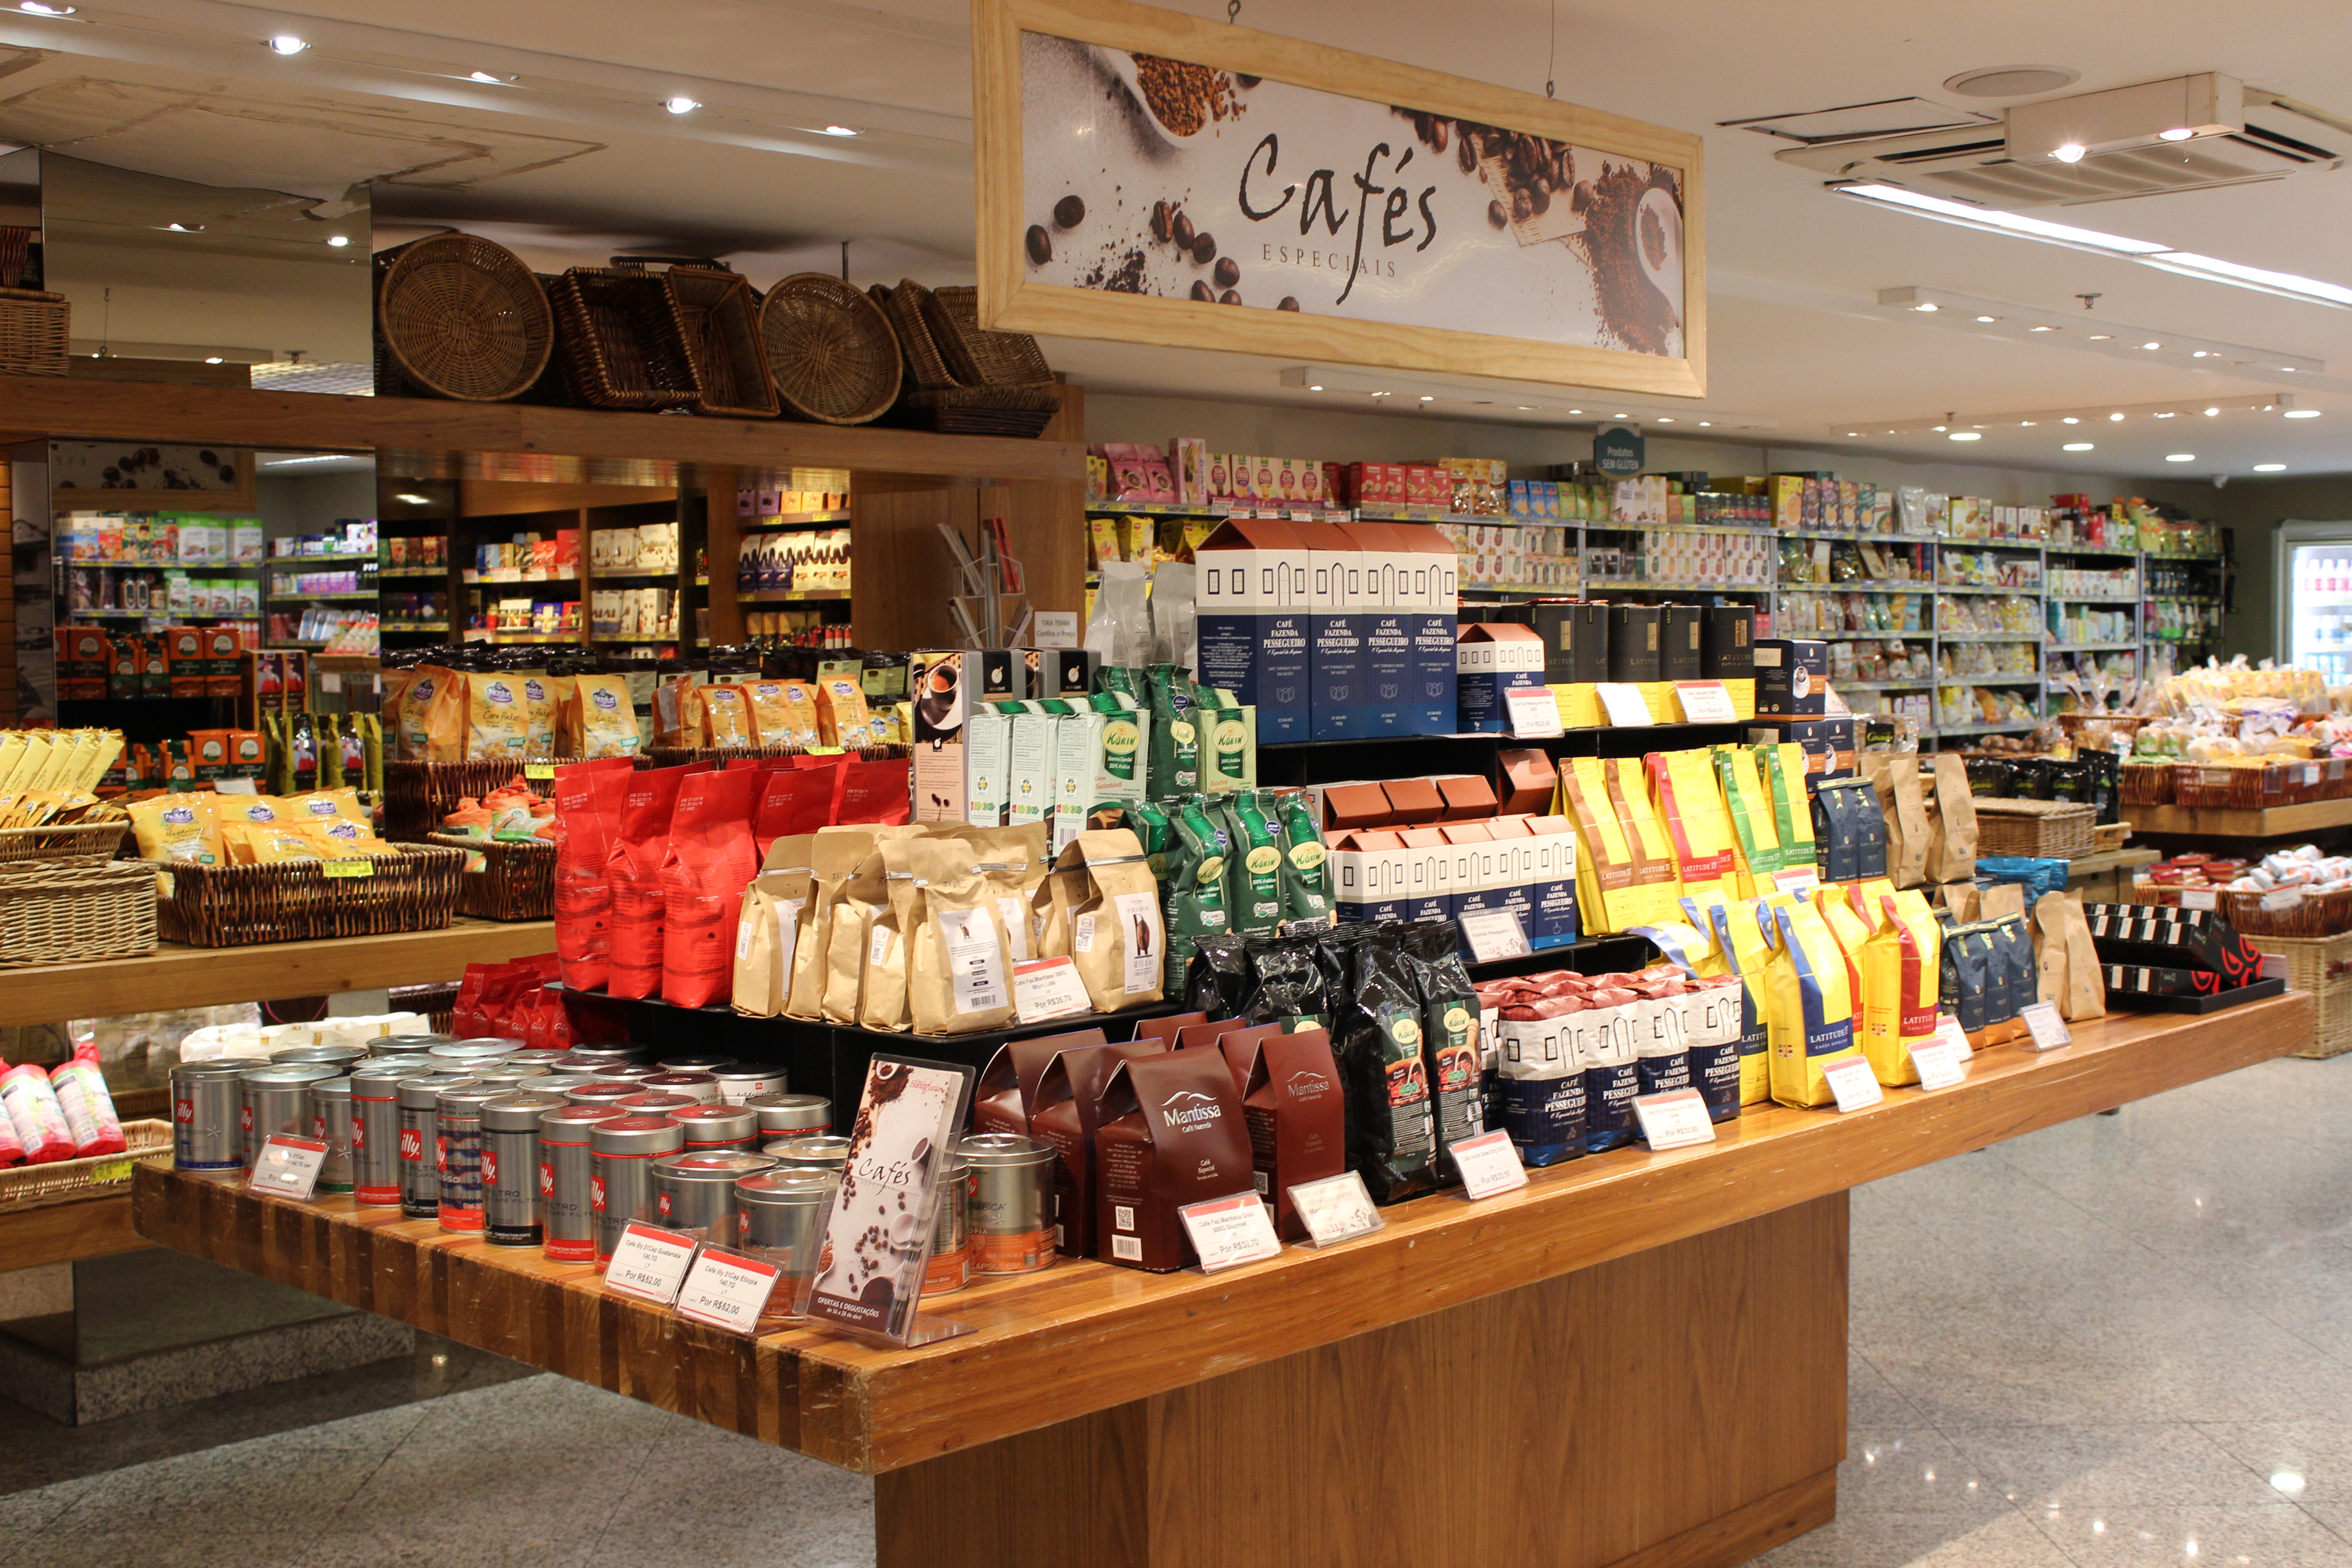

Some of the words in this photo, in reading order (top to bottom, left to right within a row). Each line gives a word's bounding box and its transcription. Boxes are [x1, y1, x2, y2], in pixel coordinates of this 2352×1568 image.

[1239, 134, 1437, 305] Cafés
[1262, 242, 1398, 278] ESPECIAIS
[1607, 446, 1634, 457] Produtos
[1602, 459, 1615, 469] SEM
[1616, 457, 1639, 469] GLÚTEN
[1276, 618, 1293, 628] CAFÉ
[1330, 618, 1346, 627] CAFÉ
[1381, 618, 1396, 627] CAFÉ
[1427, 618, 1443, 627] CAFÉ
[1263, 638, 1306, 648] PESSEGUEIRO
[1317, 637, 1359, 647] PESSEGUEIRO
[1368, 637, 1409, 646] PESSEGUEIRO
[1415, 637, 1454, 646] PESSEGUEIRO
[489, 687, 511, 698] Noglut
[483, 710, 498, 720] Corn
[500, 710, 519, 721] flakes
[1551, 883, 1563, 892] CAFÉ
[1468, 894, 1481, 903] CAFÉ
[1509, 889, 1521, 898] CAFÉ
[1547, 891, 1567, 899] FAZENDA
[1424, 899, 1437, 908] CAFÉ
[1464, 902, 1485, 911] FAZENDA
[1505, 897, 1526, 905] FAZENDA
[1541, 898, 1573, 908] PESSEGUEIRO
[1379, 904, 1392, 912] CAFÉ
[1420, 907, 1441, 916] FAZENDA
[1375, 911, 1397, 920] FAZENDA
[1035, 1001, 1046, 1009] Por
[1810, 1028, 1843, 1044] LATITUDE
[1720, 1044, 1734, 1056] CAFÉ
[1670, 1055, 1685, 1067] CAFÉ
[1714, 1054, 1739, 1066] FAZENDA
[1618, 1066, 1633, 1078] CAFÉ
[1665, 1065, 1689, 1077] FAZENDA
[1561, 1077, 1579, 1089] CAFÉ
[1612, 1076, 1637, 1088] FAZENDA
[1288, 1080, 1330, 1098] Mantissa
[1553, 1087, 1584, 1100] FAZENDA
[177, 1102, 193, 1122] illy
[1163, 1102, 1222, 1127] Mantissa
[242, 1109, 252, 1128] illy
[1182, 1124, 1194, 1133] Café
[1194, 1121, 1212, 1132] Fazenda
[402, 1133, 421, 1158] illy
[1198, 1164, 1215, 1175] Especial
[859, 1158, 911, 1196] Cafés
[659, 1195, 671, 1213] illy
[740, 1213, 749, 1231] illy
[1226, 1221, 1247, 1230] Gourmet
[625, 1239, 637, 1249] Cafe
[644, 1244, 657, 1254] 21Cap
[658, 1248, 681, 1259] Guatemala
[1220, 1244, 1232, 1254] Por
[625, 1269, 636, 1280] Por
[705, 1265, 716, 1274] Cafe
[725, 1271, 740, 1281] 21Cap
[740, 1275, 758, 1286] Etiopia
[699, 1296, 712, 1307] Por
[817, 1296, 839, 1308] OFERTAS
[843, 1303, 880, 1318] DEGUSTAÇÕES
